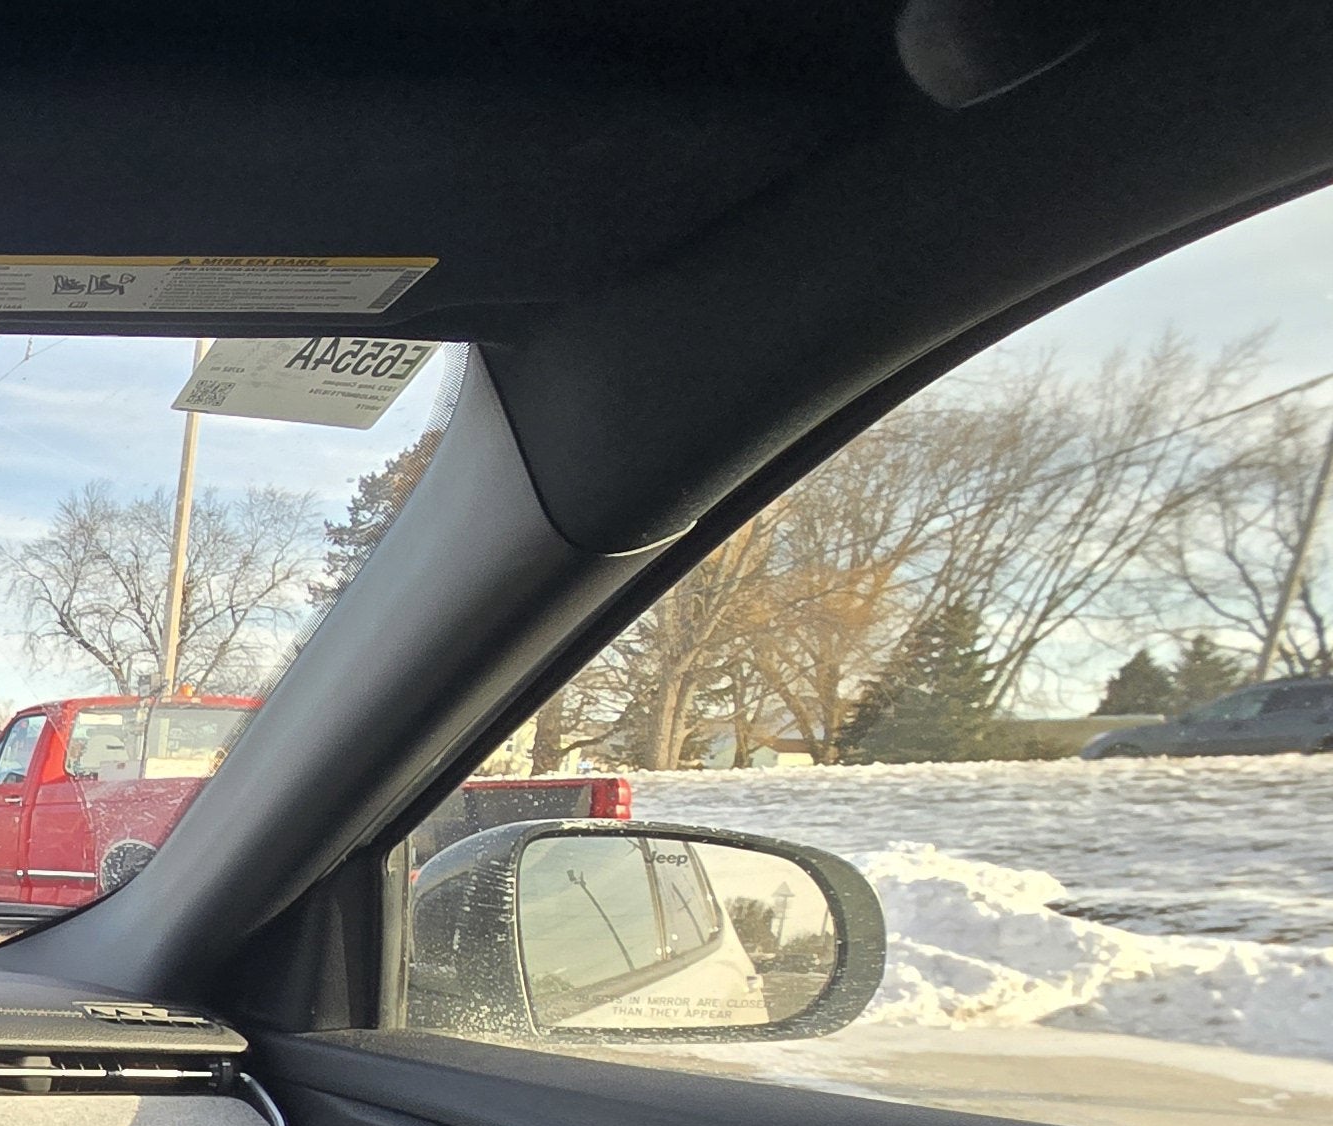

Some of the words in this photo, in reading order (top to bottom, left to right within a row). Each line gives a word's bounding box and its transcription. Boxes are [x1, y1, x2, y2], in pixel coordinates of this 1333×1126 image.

[647, 850, 688, 867] Jeep
[647, 997, 690, 1006] MIRROR
[696, 998, 718, 1007] ARE
[612, 1006, 642, 1016] THAN
[651, 1007, 678, 1017] THEY
[684, 1009, 732, 1019] APPEAR
